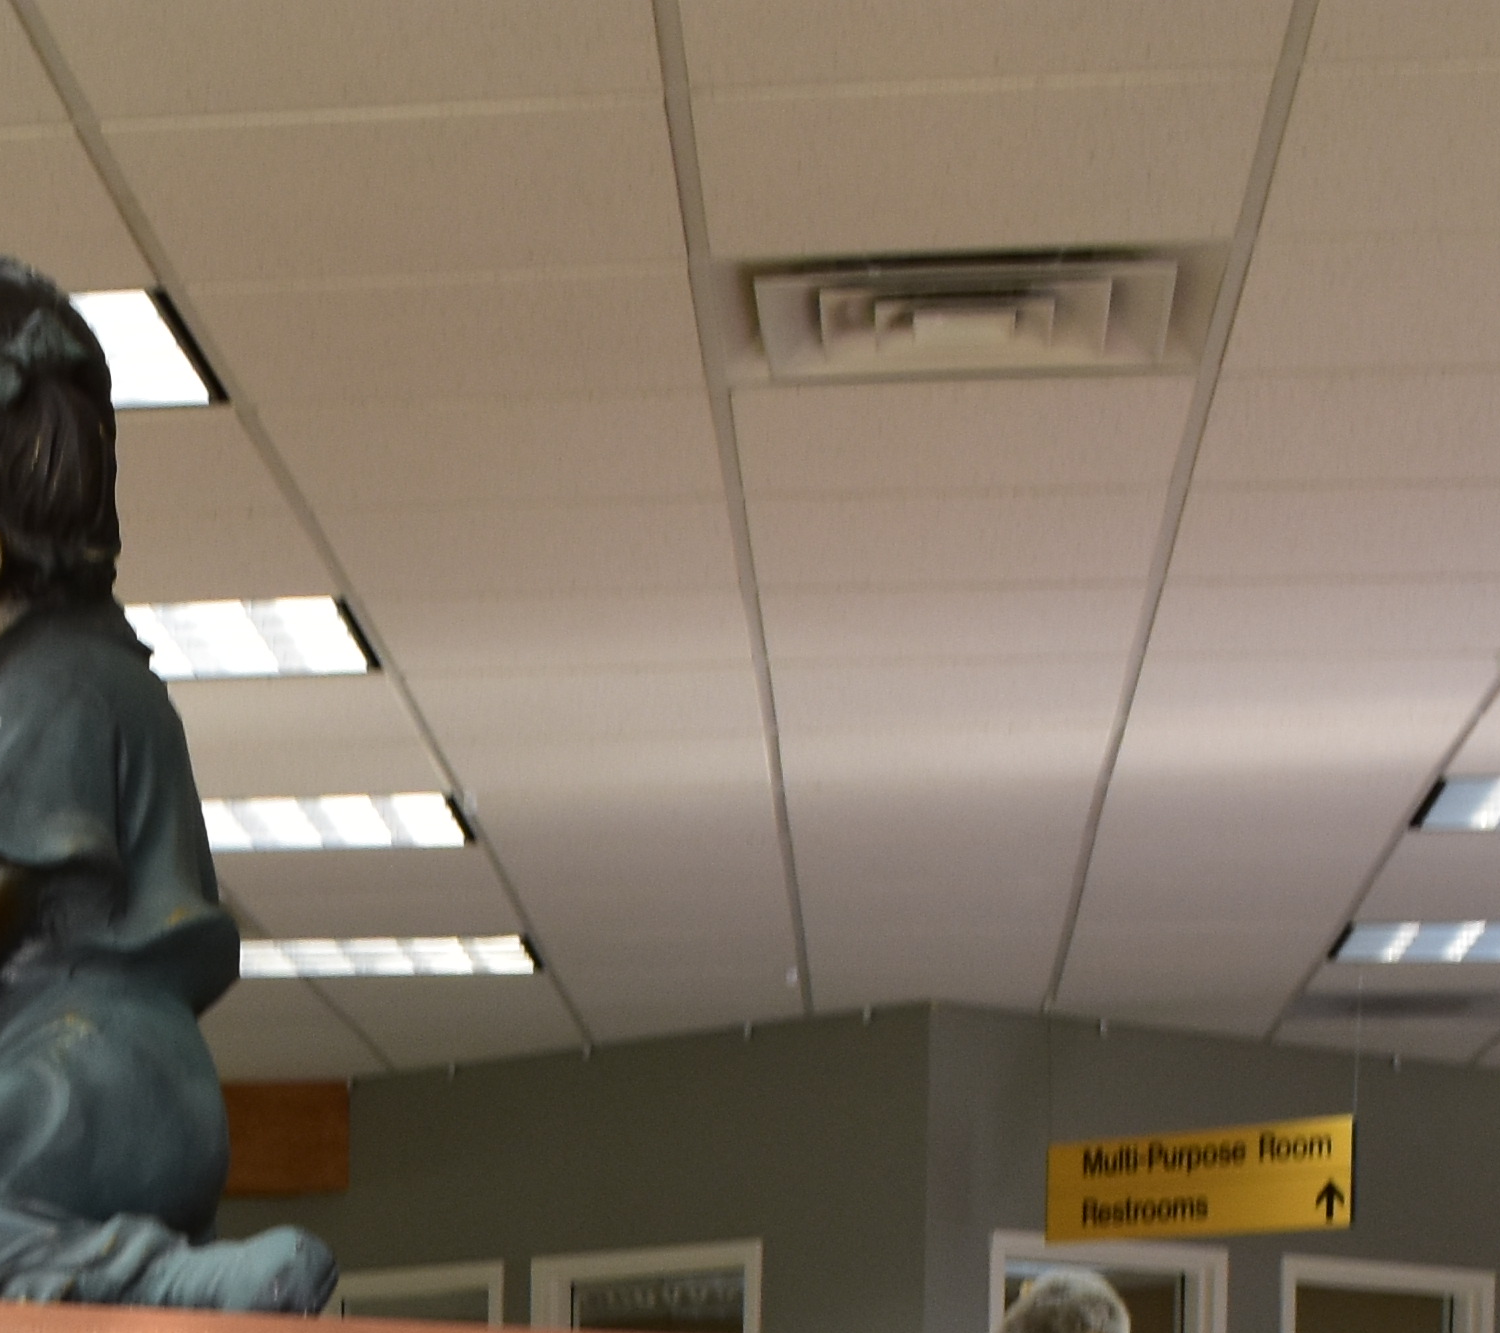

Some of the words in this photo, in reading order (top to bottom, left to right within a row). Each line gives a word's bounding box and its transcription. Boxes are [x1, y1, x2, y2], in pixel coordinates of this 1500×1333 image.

[1081, 1138, 1247, 1178] Multi-Purpose
[1258, 1130, 1333, 1165] Room
[1080, 1196, 1209, 1228] Restrooms
